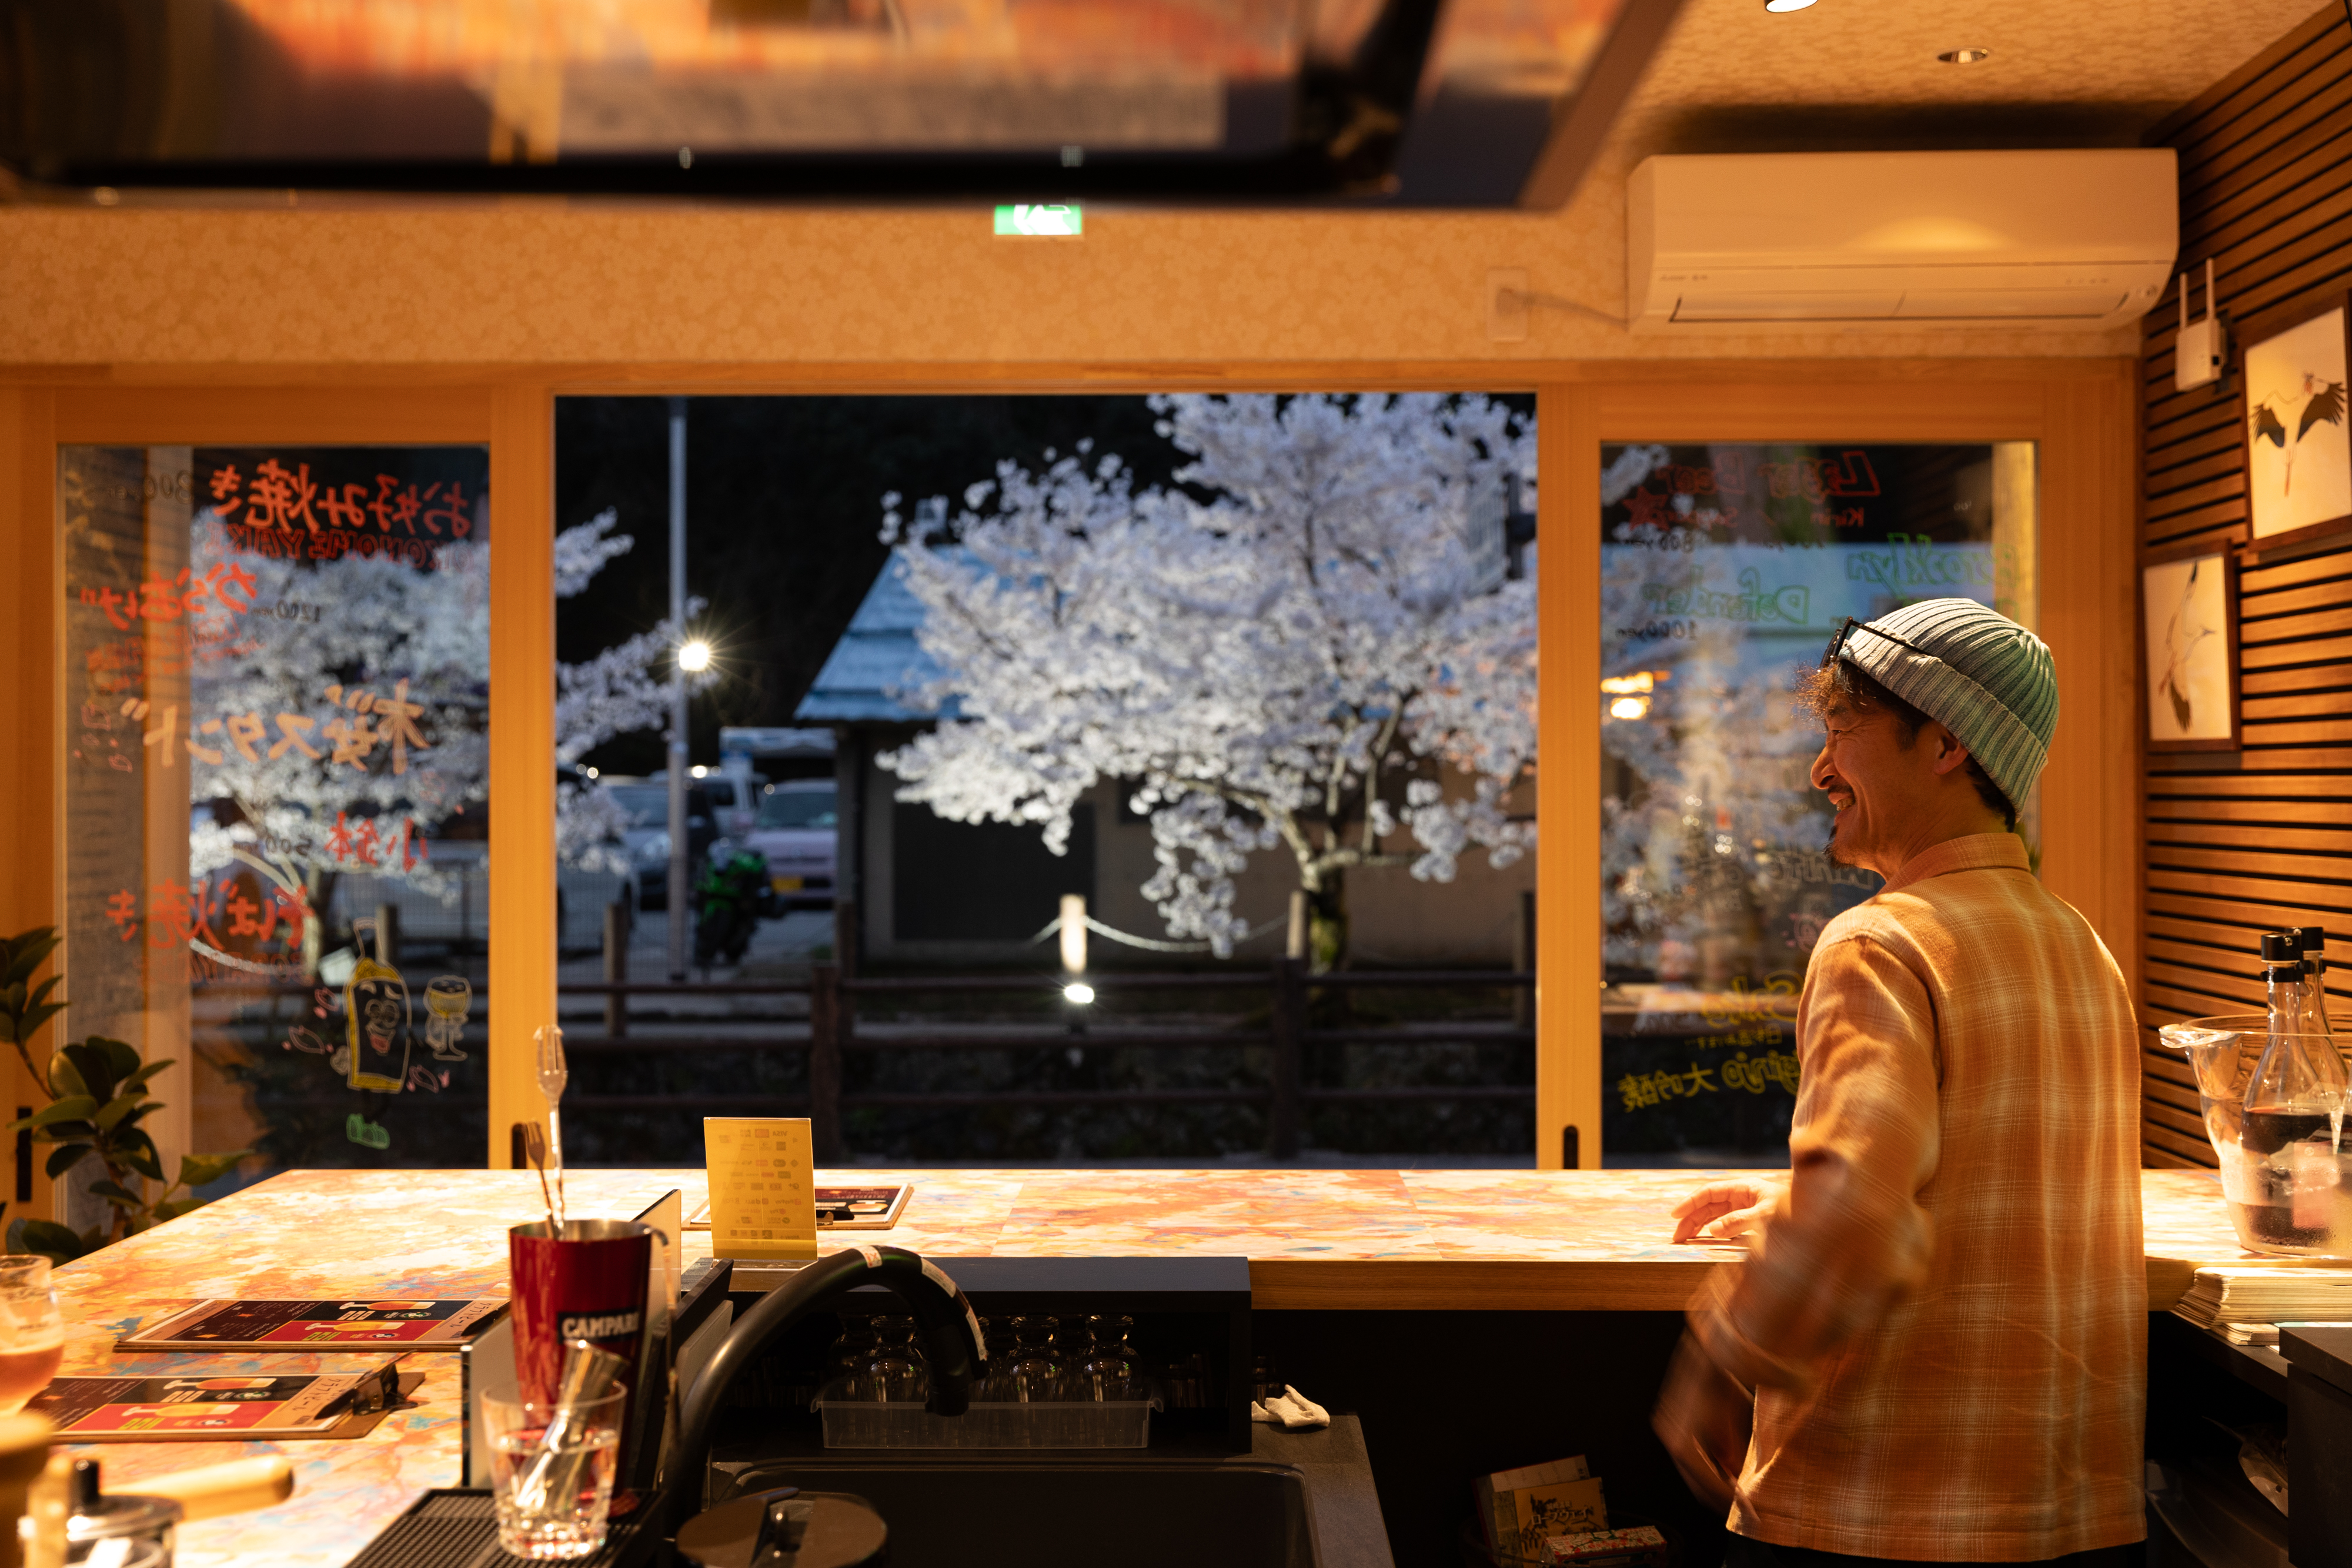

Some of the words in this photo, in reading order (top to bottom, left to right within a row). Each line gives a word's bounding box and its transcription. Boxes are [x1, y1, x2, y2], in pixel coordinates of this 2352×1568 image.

[449, 1302, 495, 1328] クラフトビール
[292, 1378, 345, 1411] クラフトビール
